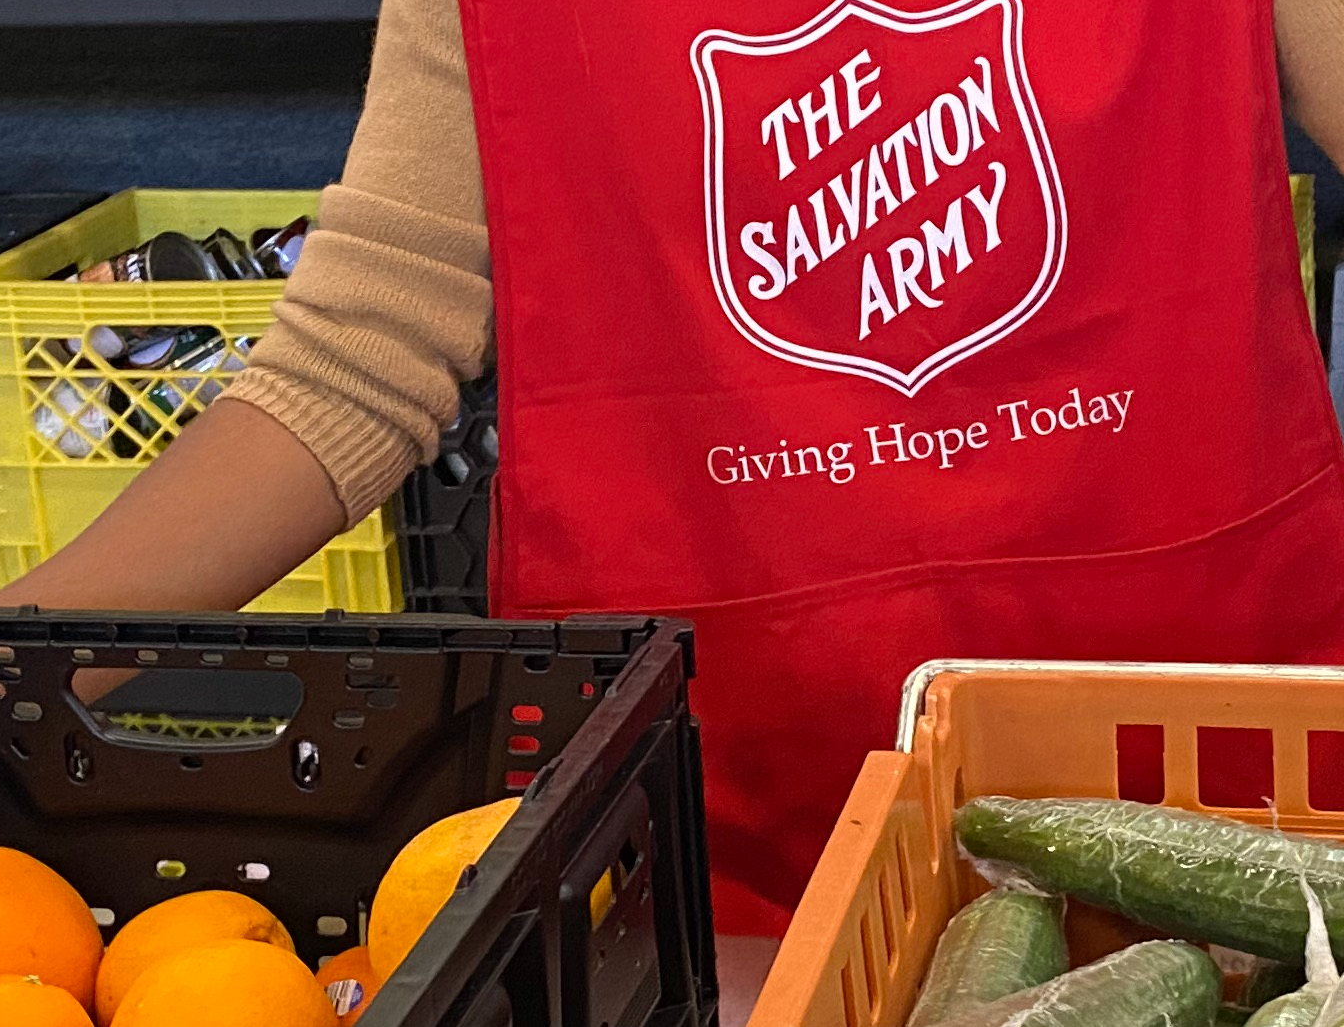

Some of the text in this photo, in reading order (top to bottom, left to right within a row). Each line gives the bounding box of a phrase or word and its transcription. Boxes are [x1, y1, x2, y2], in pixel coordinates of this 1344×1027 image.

[740, 56, 1000, 301] SALVATION
[761, 49, 881, 180] THE
[859, 161, 1006, 341] ARMY
[707, 387, 1134, 485] Giving Hope Today
